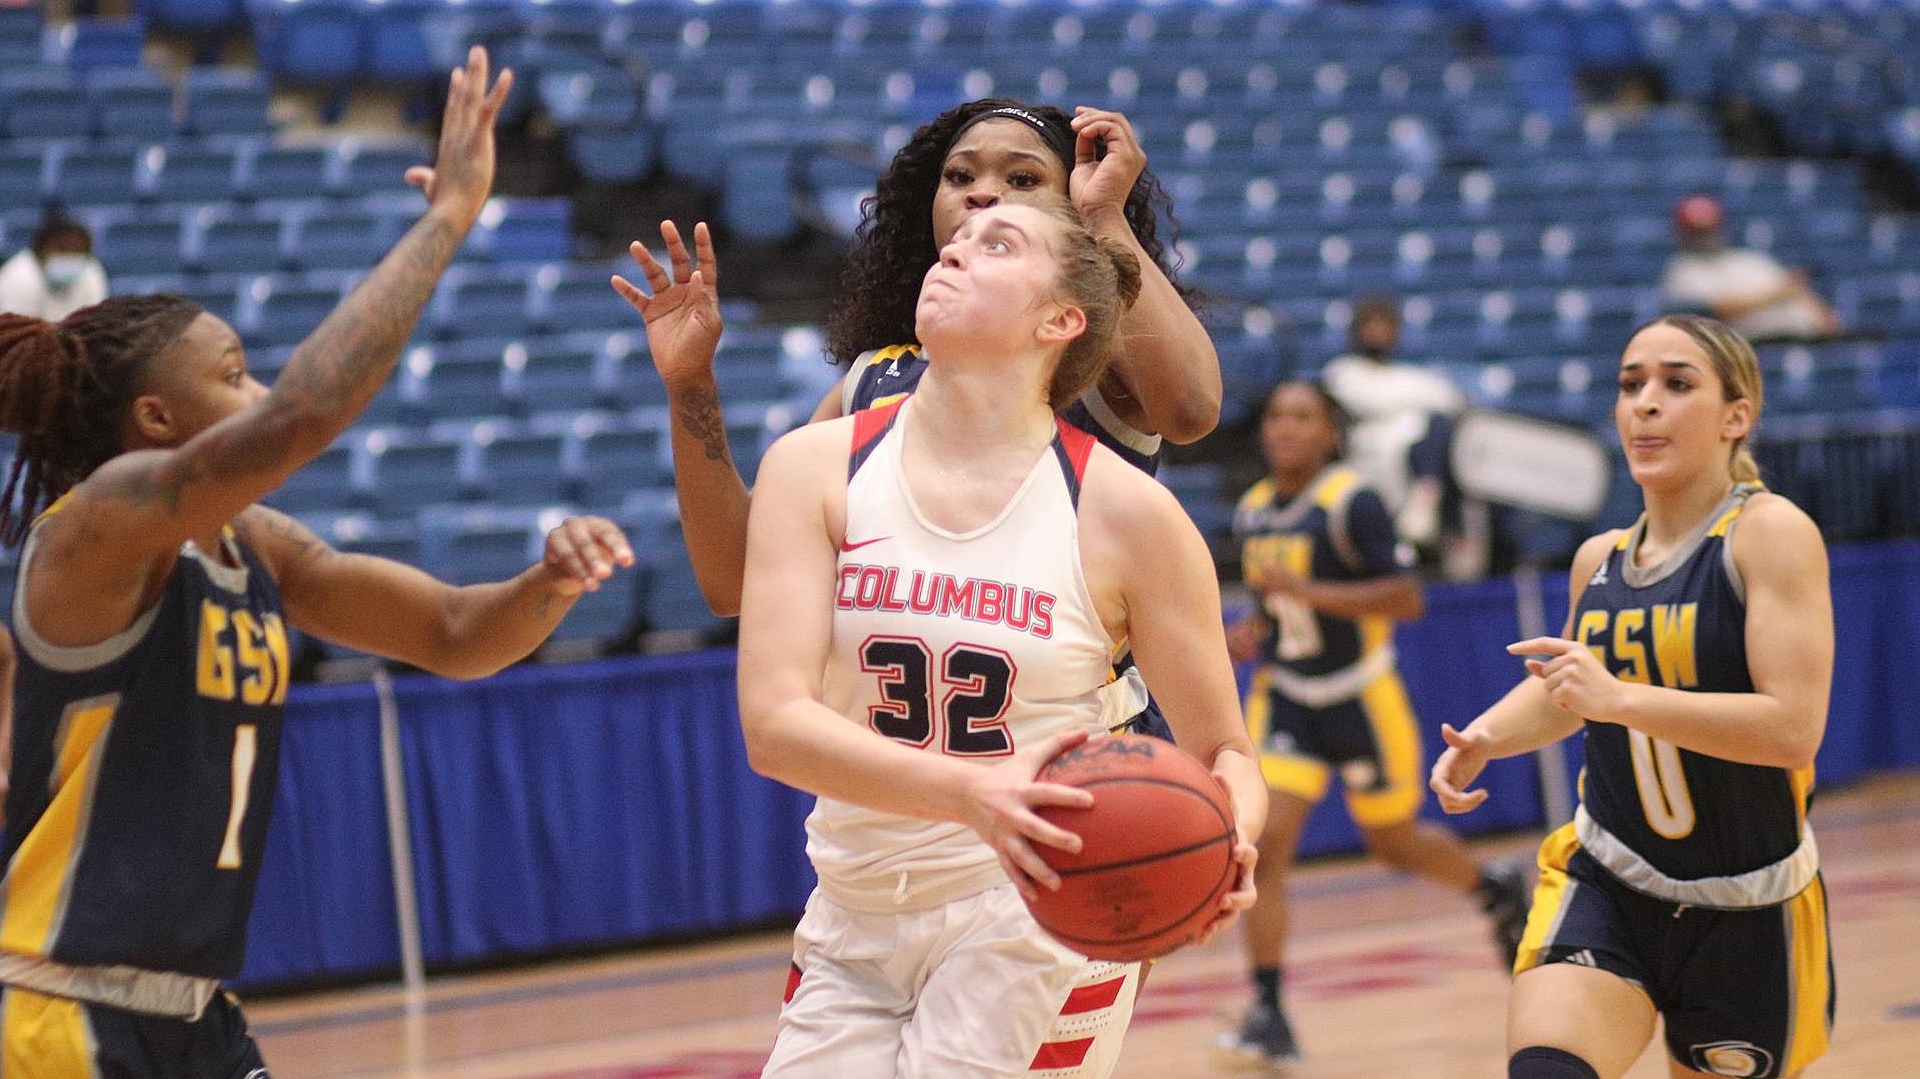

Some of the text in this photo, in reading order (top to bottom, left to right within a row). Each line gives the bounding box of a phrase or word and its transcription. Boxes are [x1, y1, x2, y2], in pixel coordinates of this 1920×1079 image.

[836, 563, 1058, 641] COLUMBUS
[1577, 601, 1699, 688] GSW
[858, 634, 1018, 758] 32
[215, 722, 258, 870] 1
